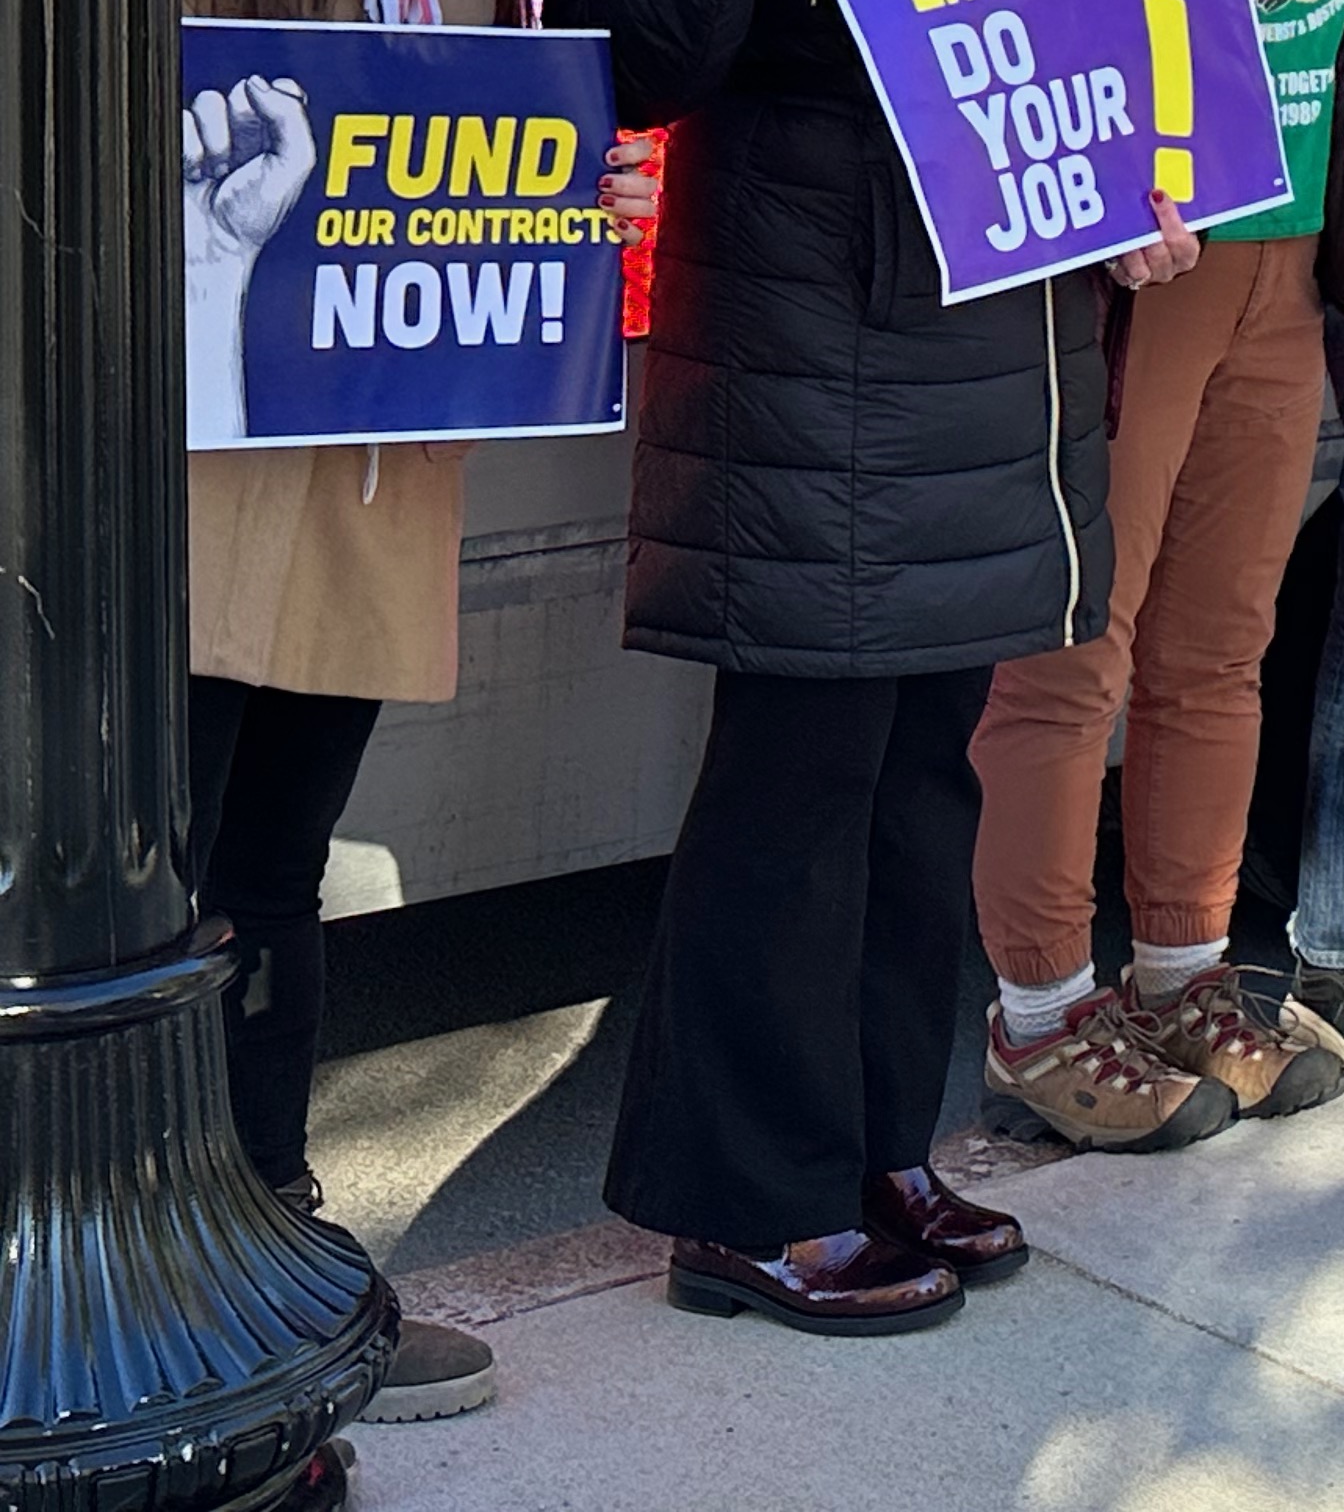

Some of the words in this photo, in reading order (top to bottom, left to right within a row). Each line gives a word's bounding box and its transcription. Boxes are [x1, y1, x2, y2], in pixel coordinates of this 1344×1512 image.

[928, 9, 1037, 100] DO
[324, 113, 579, 200] FUND
[957, 65, 1135, 171] YOUR
[316, 208, 397, 248] OUR
[985, 153, 1106, 253] JOB
[310, 260, 567, 351] NOW!
